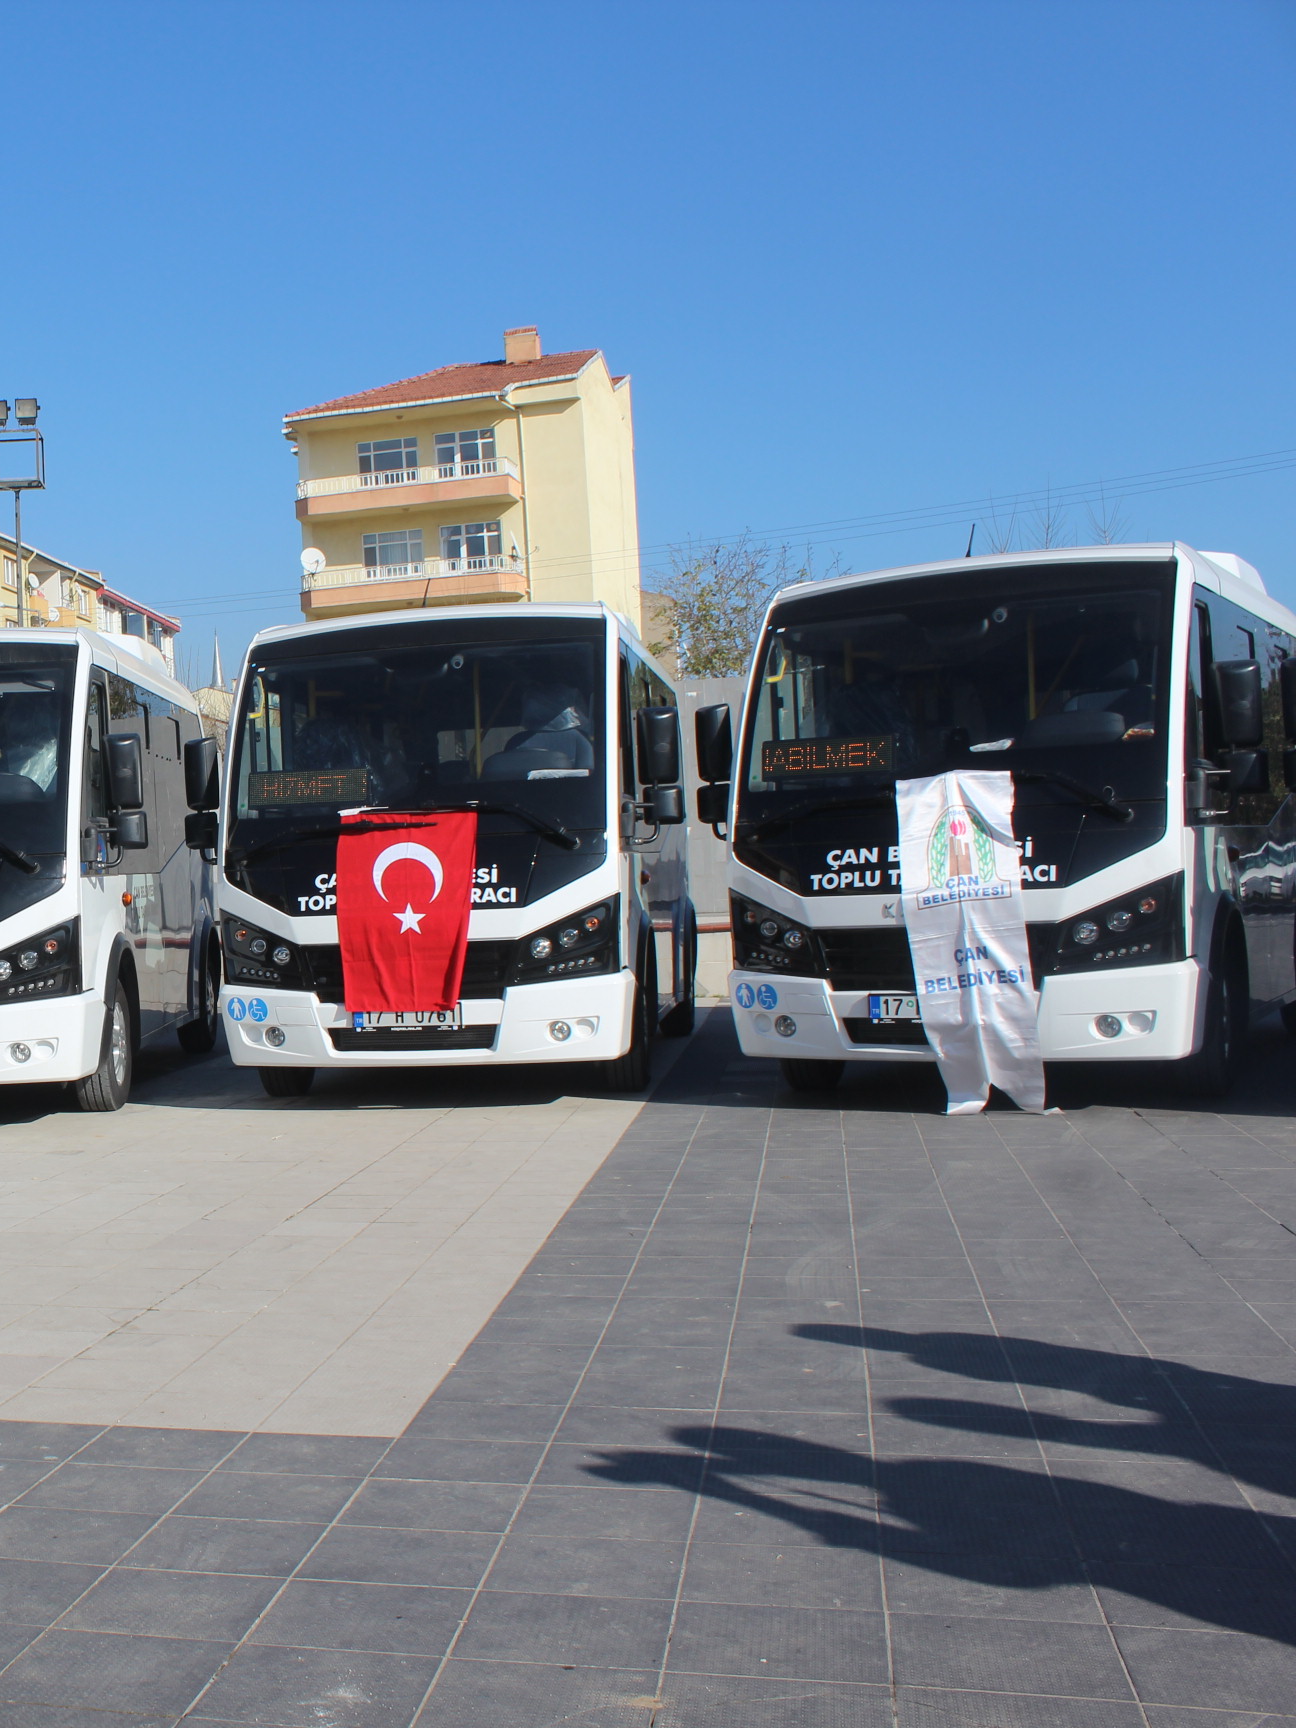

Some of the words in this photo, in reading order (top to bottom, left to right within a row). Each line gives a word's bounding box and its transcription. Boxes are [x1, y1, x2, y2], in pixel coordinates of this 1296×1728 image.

[826, 847, 878, 870] ÇAN
[810, 870, 881, 890] TOPLU
[1020, 865, 1056, 881] ACI
[945, 875, 979, 893] ÇAN
[298, 895, 337, 911] TOP
[471, 887, 516, 902] RACI
[922, 884, 1005, 906] BELEDİYESİ
[954, 946, 989, 967] ÇAN
[924, 965, 1026, 994] BELEDİYESİ
[883, 998, 903, 1016] 17
